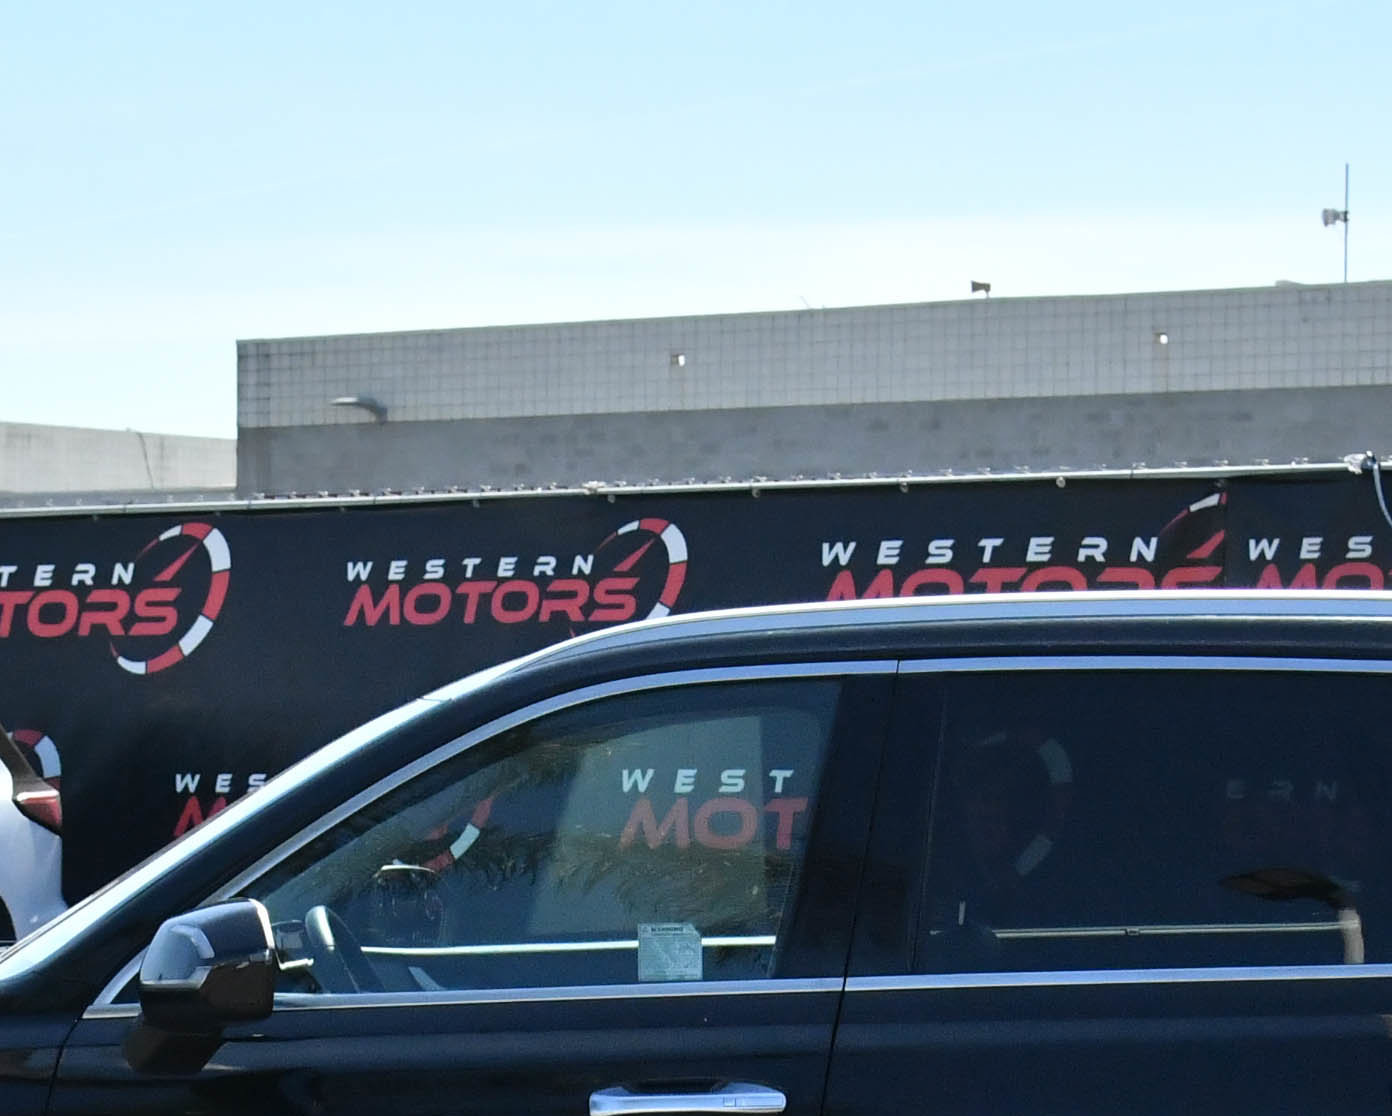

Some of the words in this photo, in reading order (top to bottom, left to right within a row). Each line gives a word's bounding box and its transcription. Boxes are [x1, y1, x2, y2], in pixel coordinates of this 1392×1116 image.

[822, 536, 1158, 567] WESTERN
[347, 554, 594, 582] WESTERN
[344, 577, 639, 627] MOTORS
